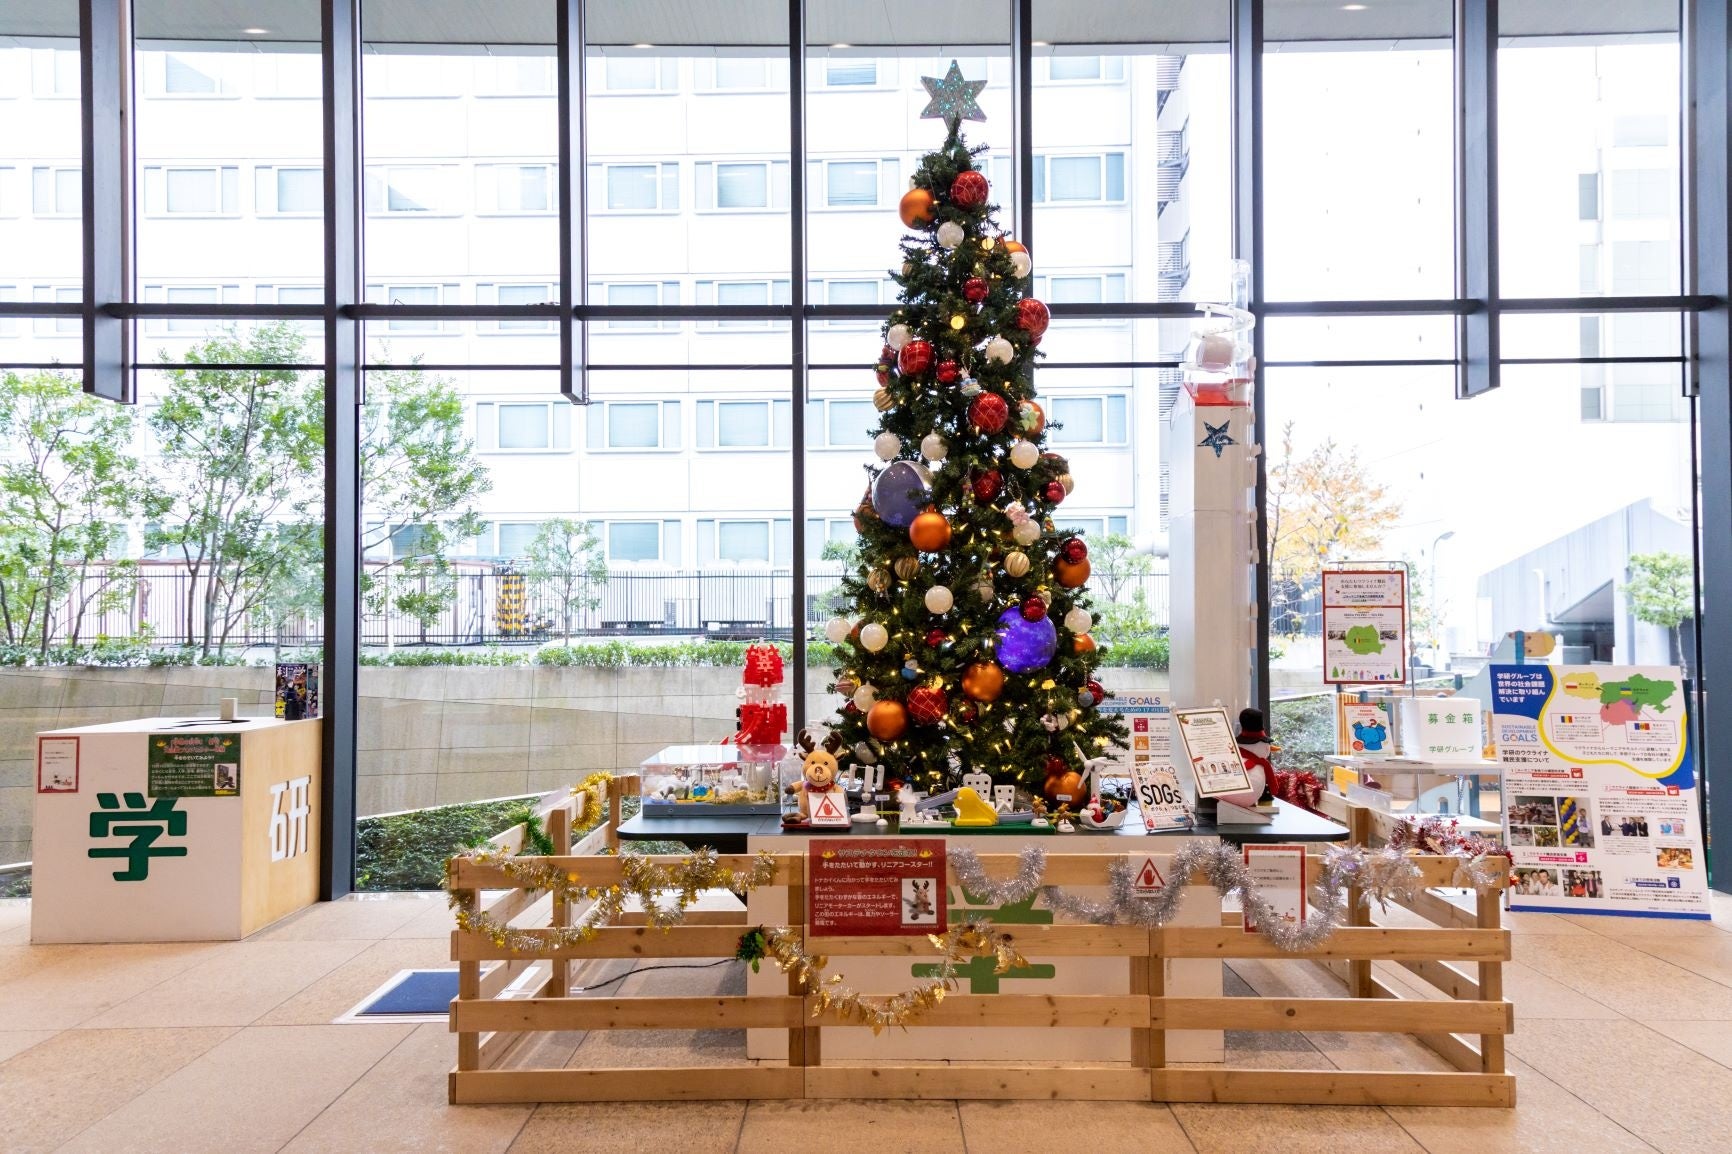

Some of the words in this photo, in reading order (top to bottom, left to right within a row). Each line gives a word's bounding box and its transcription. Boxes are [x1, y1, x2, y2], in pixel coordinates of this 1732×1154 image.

[1498, 688, 1546, 696] 解決に取り組ん
[1129, 696, 1161, 706] GOALS
[1428, 713, 1473, 725] 募金箱
[1502, 733, 1538, 742] GOALS
[1429, 745, 1475, 753] 学研グループ
[1140, 783, 1182, 806] SDGs
[268, 775, 311, 862] 研
[88, 792, 187, 882] 学
